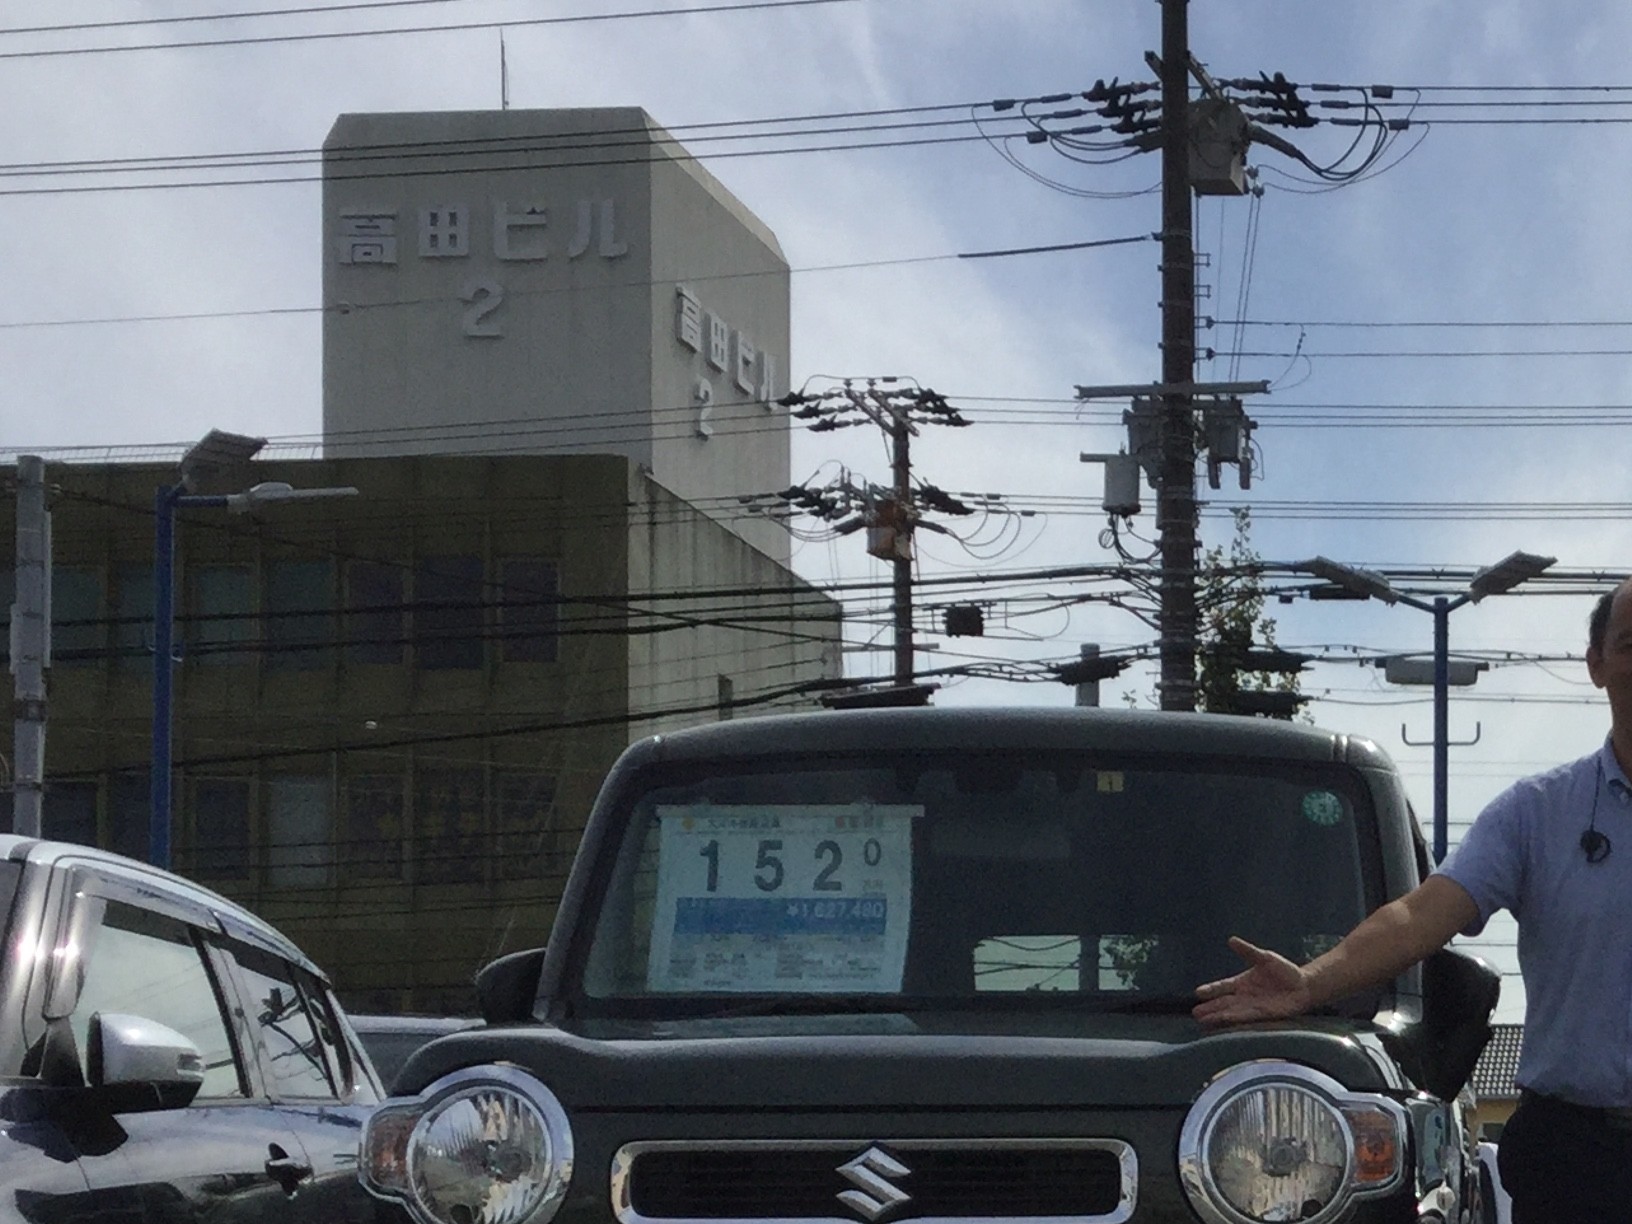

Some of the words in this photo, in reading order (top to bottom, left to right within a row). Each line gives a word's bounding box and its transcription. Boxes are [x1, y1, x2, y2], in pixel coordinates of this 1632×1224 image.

[337, 200, 628, 264] 高田ビル
[462, 278, 503, 338] 2
